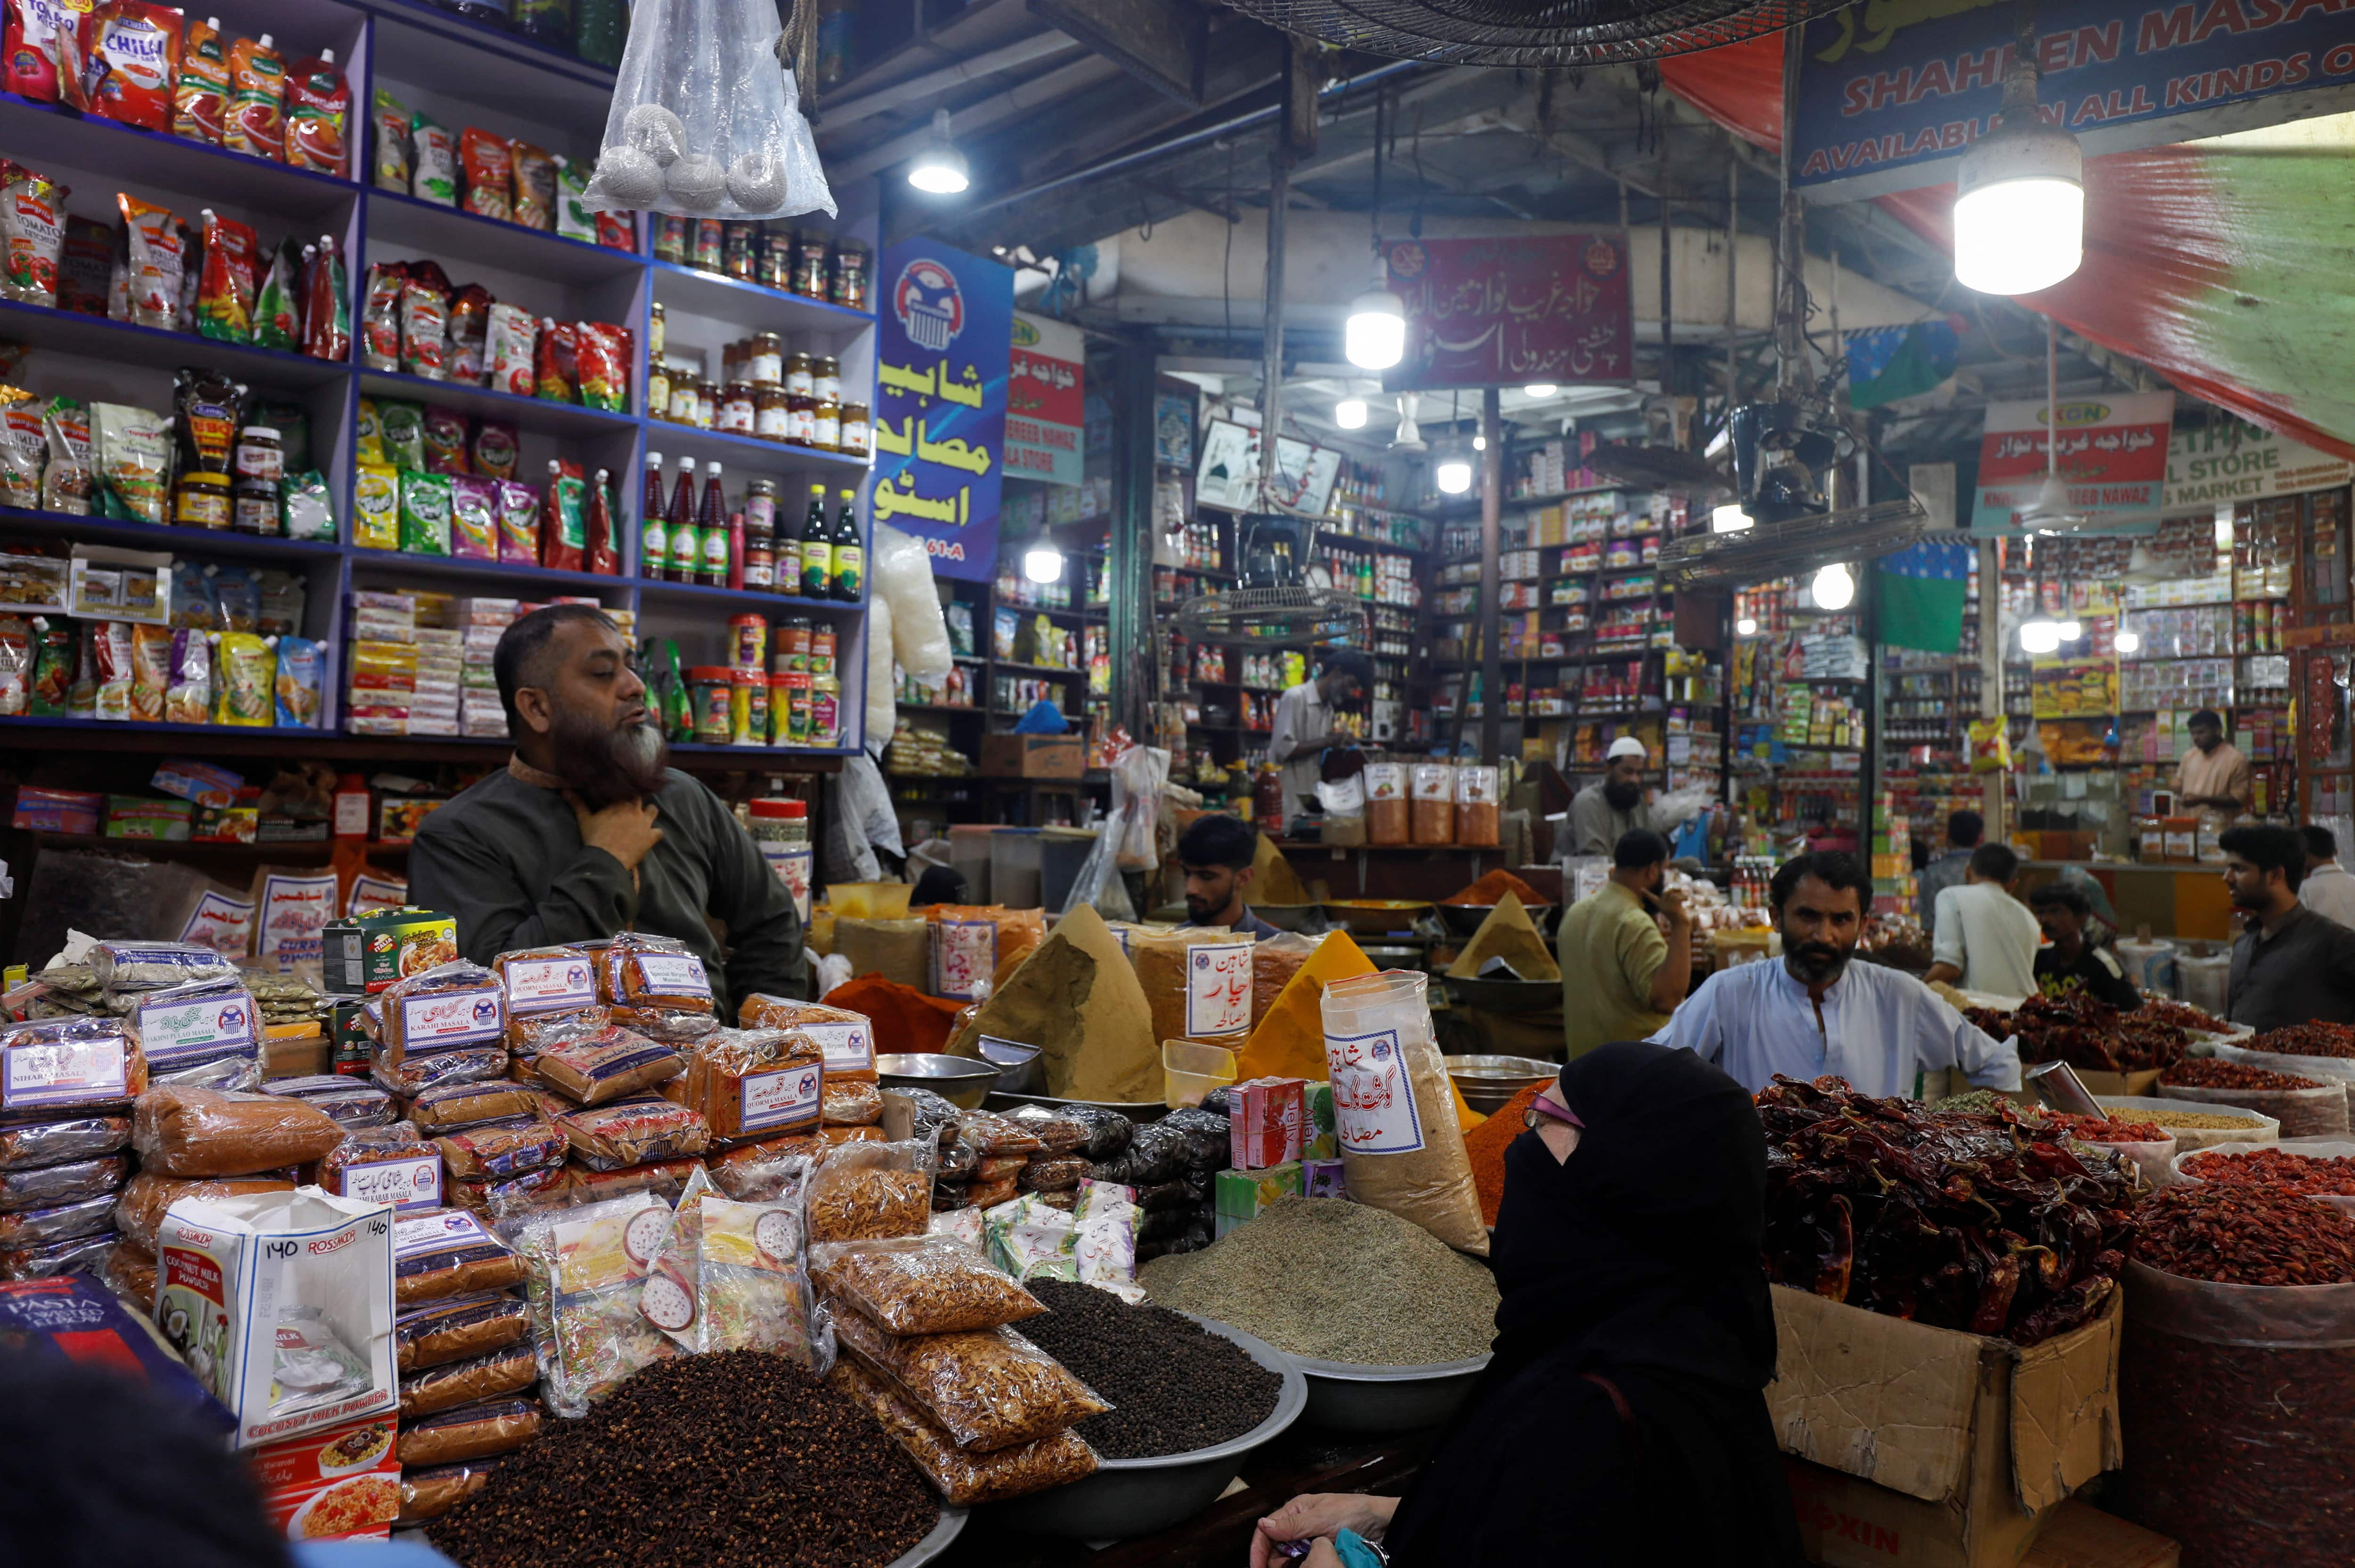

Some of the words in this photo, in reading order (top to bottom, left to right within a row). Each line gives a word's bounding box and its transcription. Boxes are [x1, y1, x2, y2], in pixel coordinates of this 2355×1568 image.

[2137, 0, 2355, 53] MASA
[2072, 86, 2156, 126] ALL
[2166, 52, 2310, 107] KINDS
[2323, 43, 2355, 75] O
[16, 214, 63, 239] TOMATO
[2189, 447, 2280, 480] STORE
[2103, 486, 2151, 504] NAWAZ
[2178, 477, 2264, 502] MARKET
[927, 539, 964, 560] 61-A
[278, 938, 323, 950] CURR
[374, 938, 394, 953] ITALIA
[401, 930, 437, 946] Chicken
[417, 938, 439, 950] Stock
[1215, 948, 1249, 973] شاہین
[514, 984, 542, 993] QUORMA
[1202, 974, 1252, 1009] اچار
[350, 1022, 362, 1031] ITA
[411, 1023, 439, 1031] KARAHI
[441, 1019, 470, 1027] MASALA
[146, 1034, 169, 1043] YAKHNI
[170, 1032, 191, 1040] PULAO
[192, 1029, 216, 1038] MASALA
[53, 1070, 87, 1079] MASALA
[753, 1076, 786, 1100] قورمہ
[1360, 1064, 1397, 1112] گوشت
[747, 1099, 773, 1108] QUORMA
[774, 1093, 797, 1102] MASALA
[1284, 1102, 1298, 1142] Jelly
[1303, 1108, 1316, 1148] Jelly
[1236, 1143, 1244, 1166] Jelly
[371, 1193, 390, 1203] KABAB
[390, 1190, 412, 1200] MASALA
[177, 1227, 213, 1249] ROSSMOOR
[367, 1220, 388, 1236] 140
[419, 1229, 446, 1238] MASALA
[267, 1241, 298, 1260] 140
[307, 1229, 356, 1255] ROSSMOOR
[166, 1255, 199, 1276] COCONUT
[201, 1268, 219, 1283] MILK
[179, 1270, 209, 1291] POWDER
[7, 1298, 102, 1314] PASTA
[247, 1414, 309, 1439] COCONUT
[310, 1406, 341, 1423] MILK
[341, 1389, 388, 1414] POWDER
[264, 1457, 296, 1469] Macaroni
